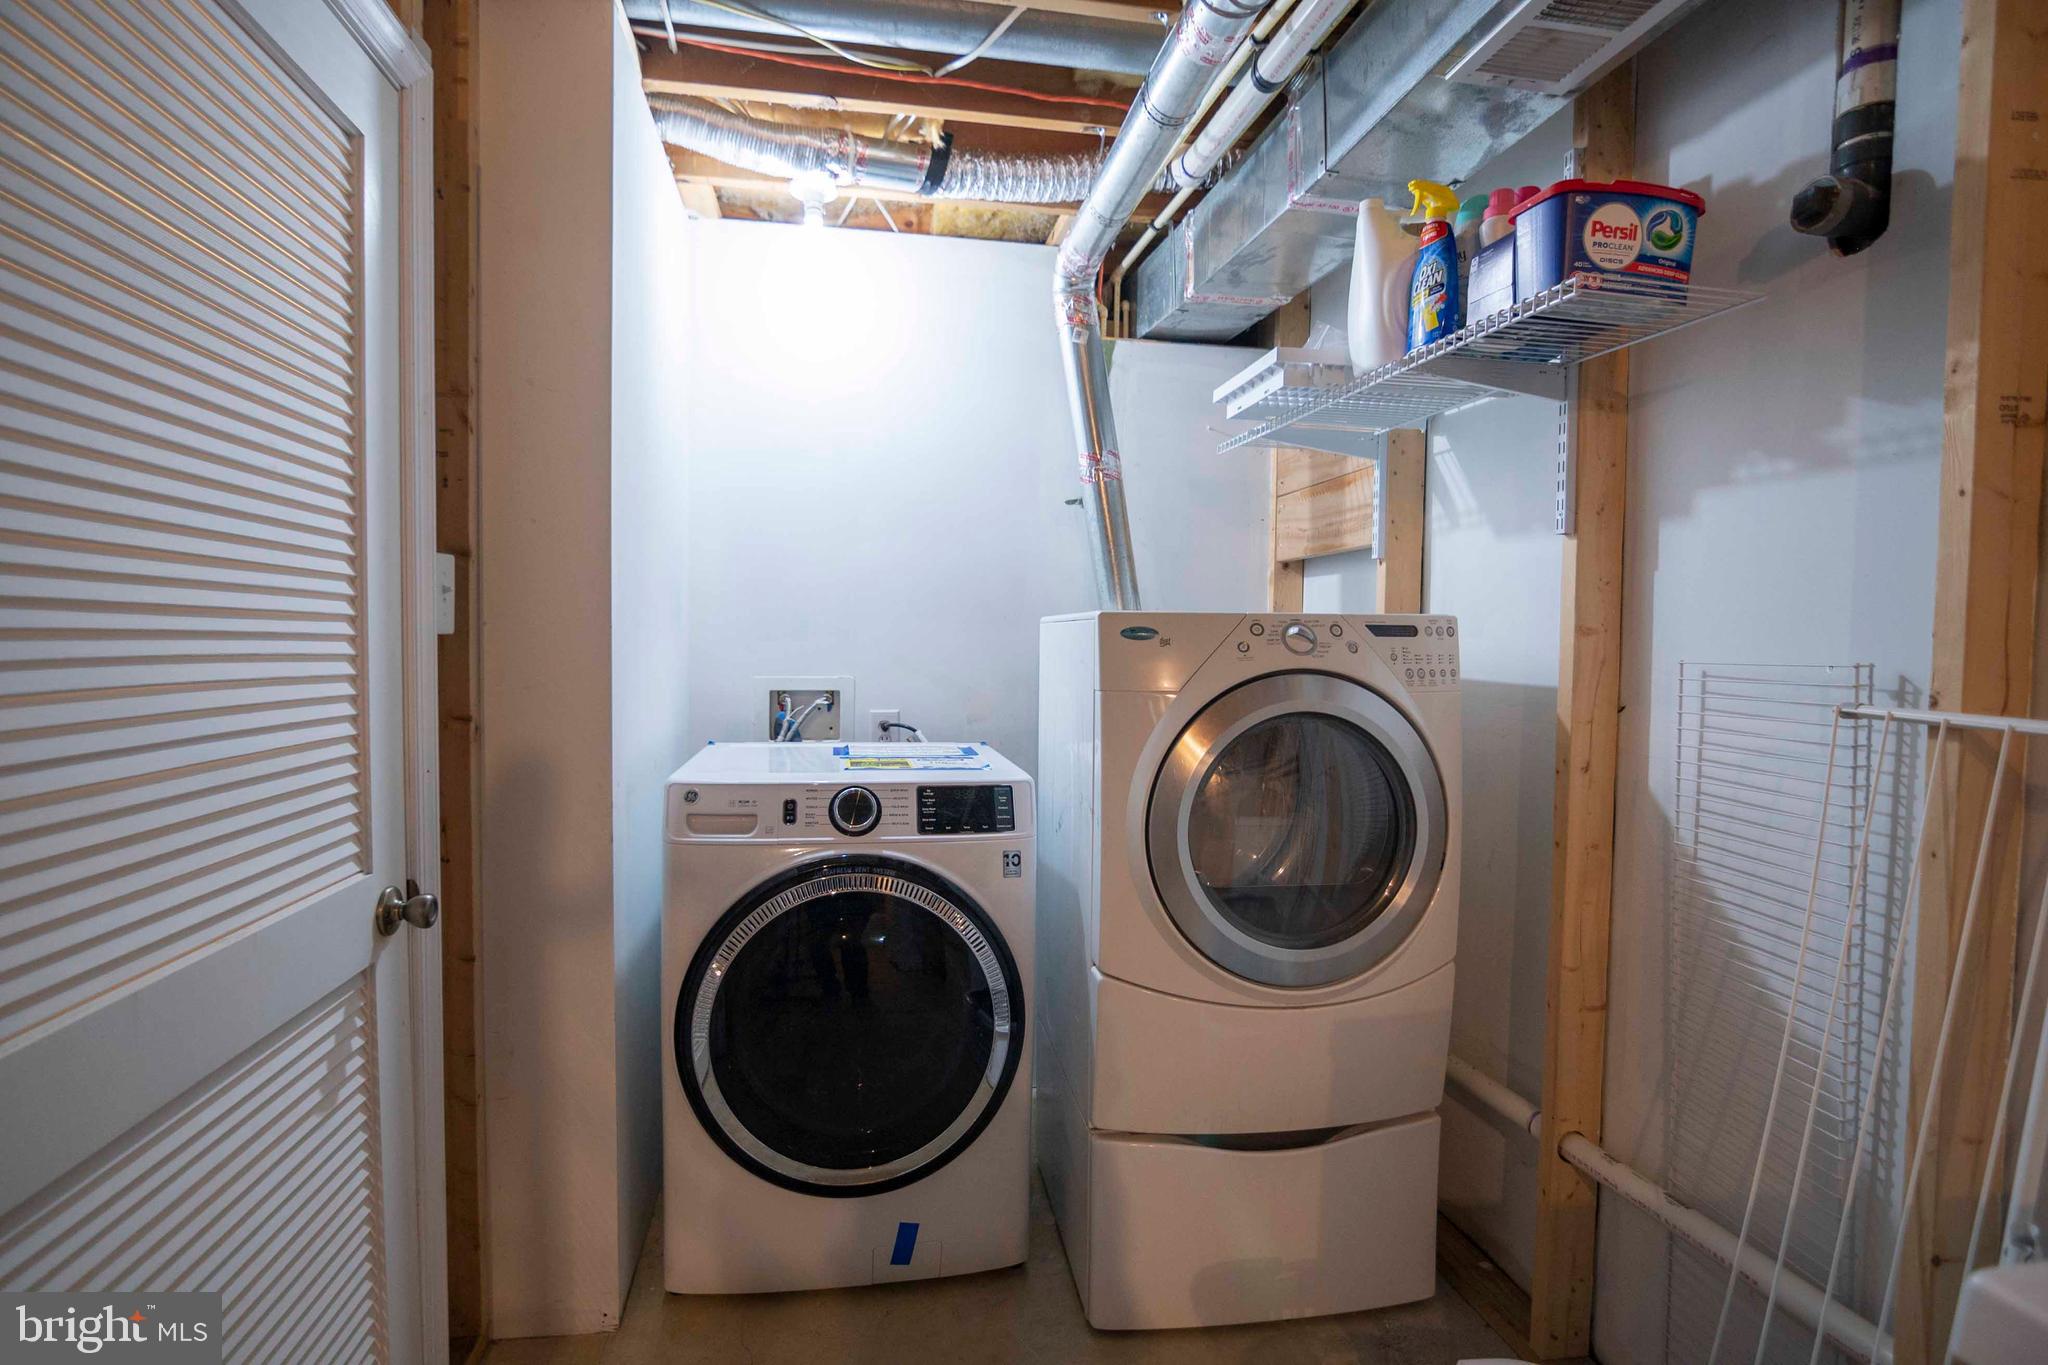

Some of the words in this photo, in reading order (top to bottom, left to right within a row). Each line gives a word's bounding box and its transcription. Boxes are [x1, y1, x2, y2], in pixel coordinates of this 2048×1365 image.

[1590, 220, 1638, 241] Persil
[1591, 241, 1634, 251] PROCLEAN
[1599, 257, 1624, 265] DISCS
[1419, 262, 1437, 281] OXI
[1413, 270, 1443, 294] CLEAN
